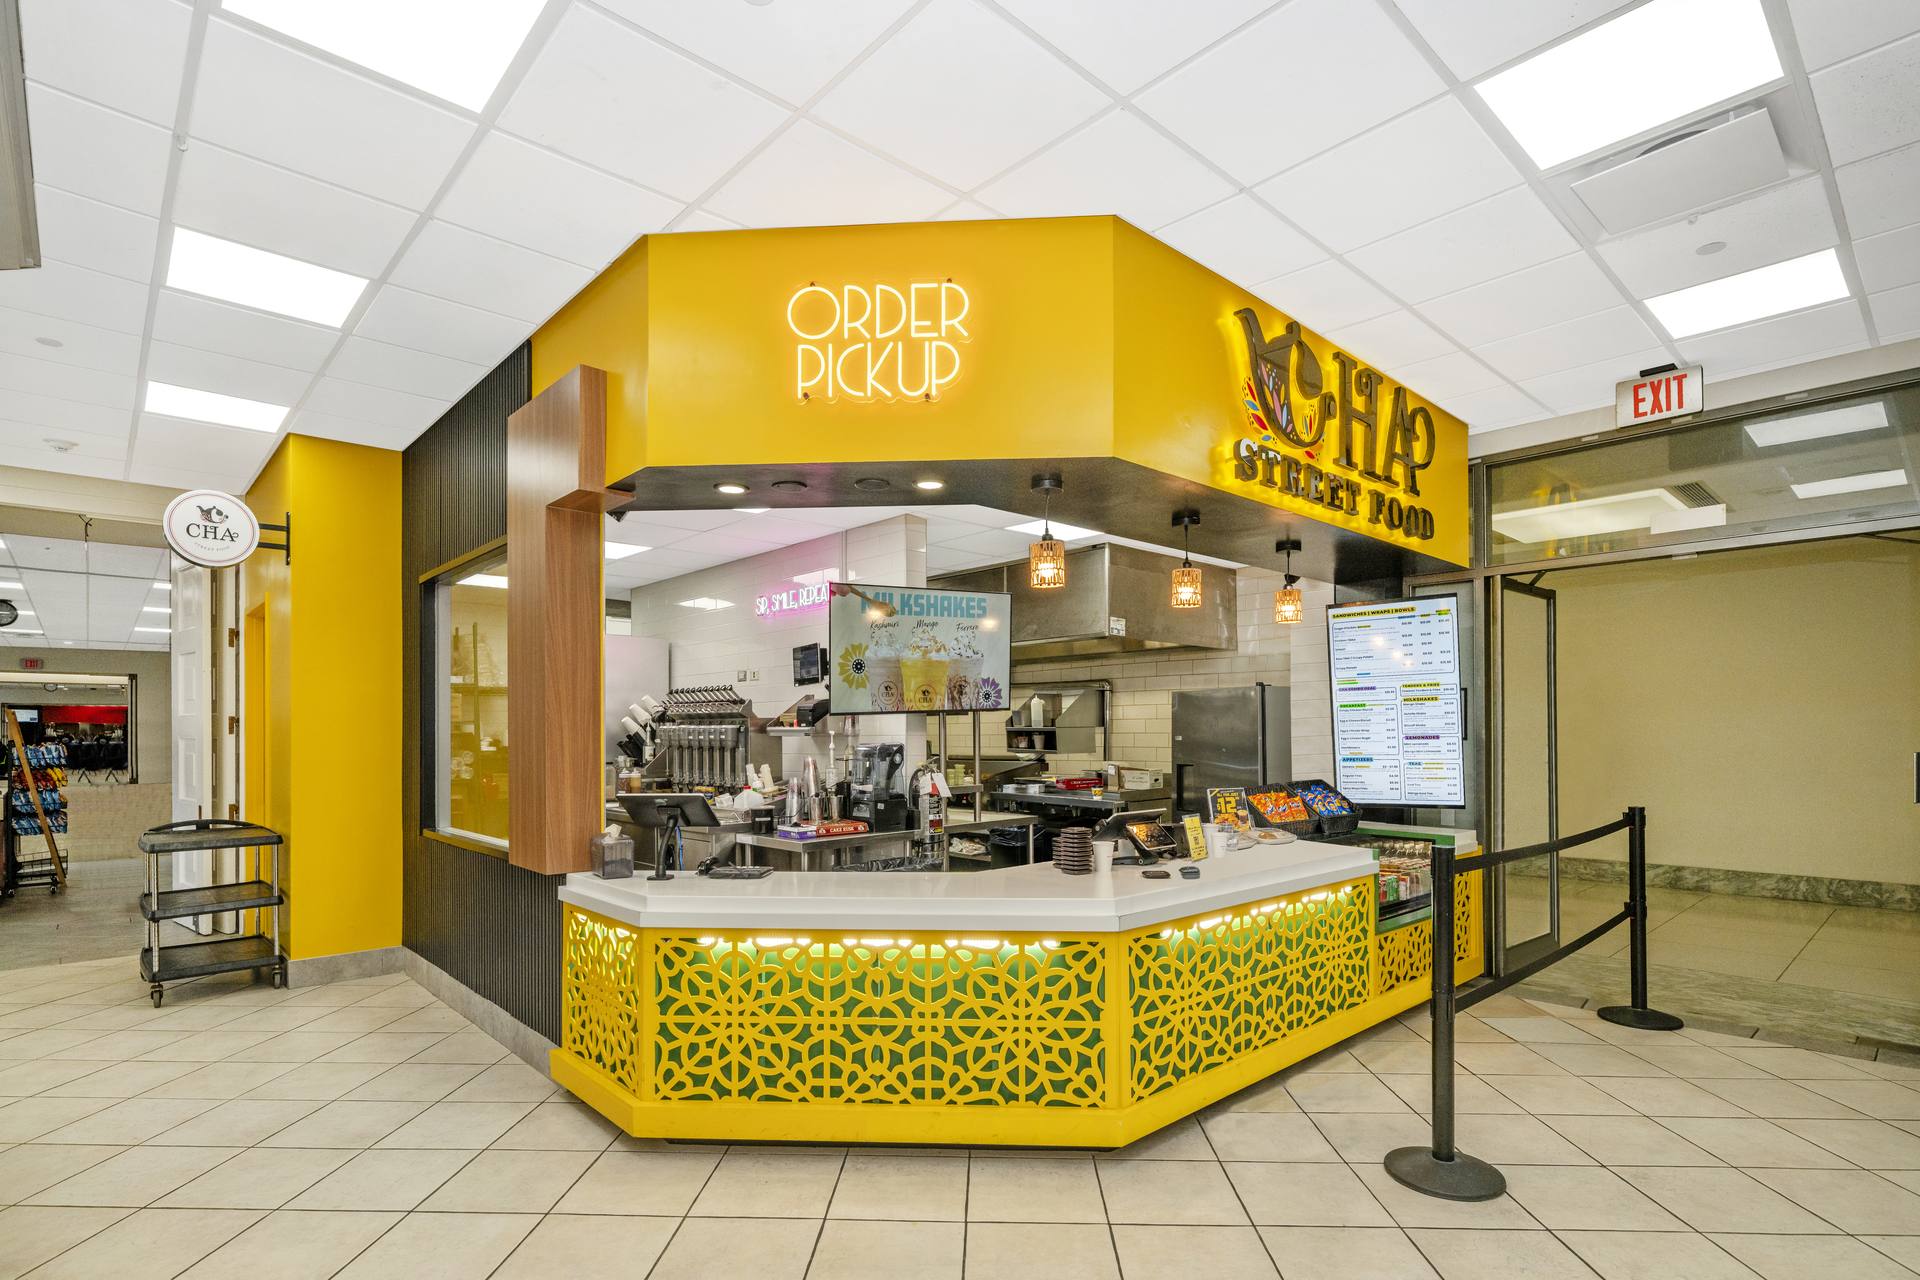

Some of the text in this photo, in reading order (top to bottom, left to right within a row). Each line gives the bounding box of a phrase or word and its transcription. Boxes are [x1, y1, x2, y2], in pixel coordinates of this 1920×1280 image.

[787, 282, 969, 340] ORDER
[797, 341, 960, 399] PICKUP
[1633, 373, 1688, 419] EXIT
[1233, 438, 1435, 541] STREET FOOD
[186, 523, 239, 542] CHA
[915, 620, 939, 631] Mango
[1333, 611, 1366, 619] SANDWICHES
